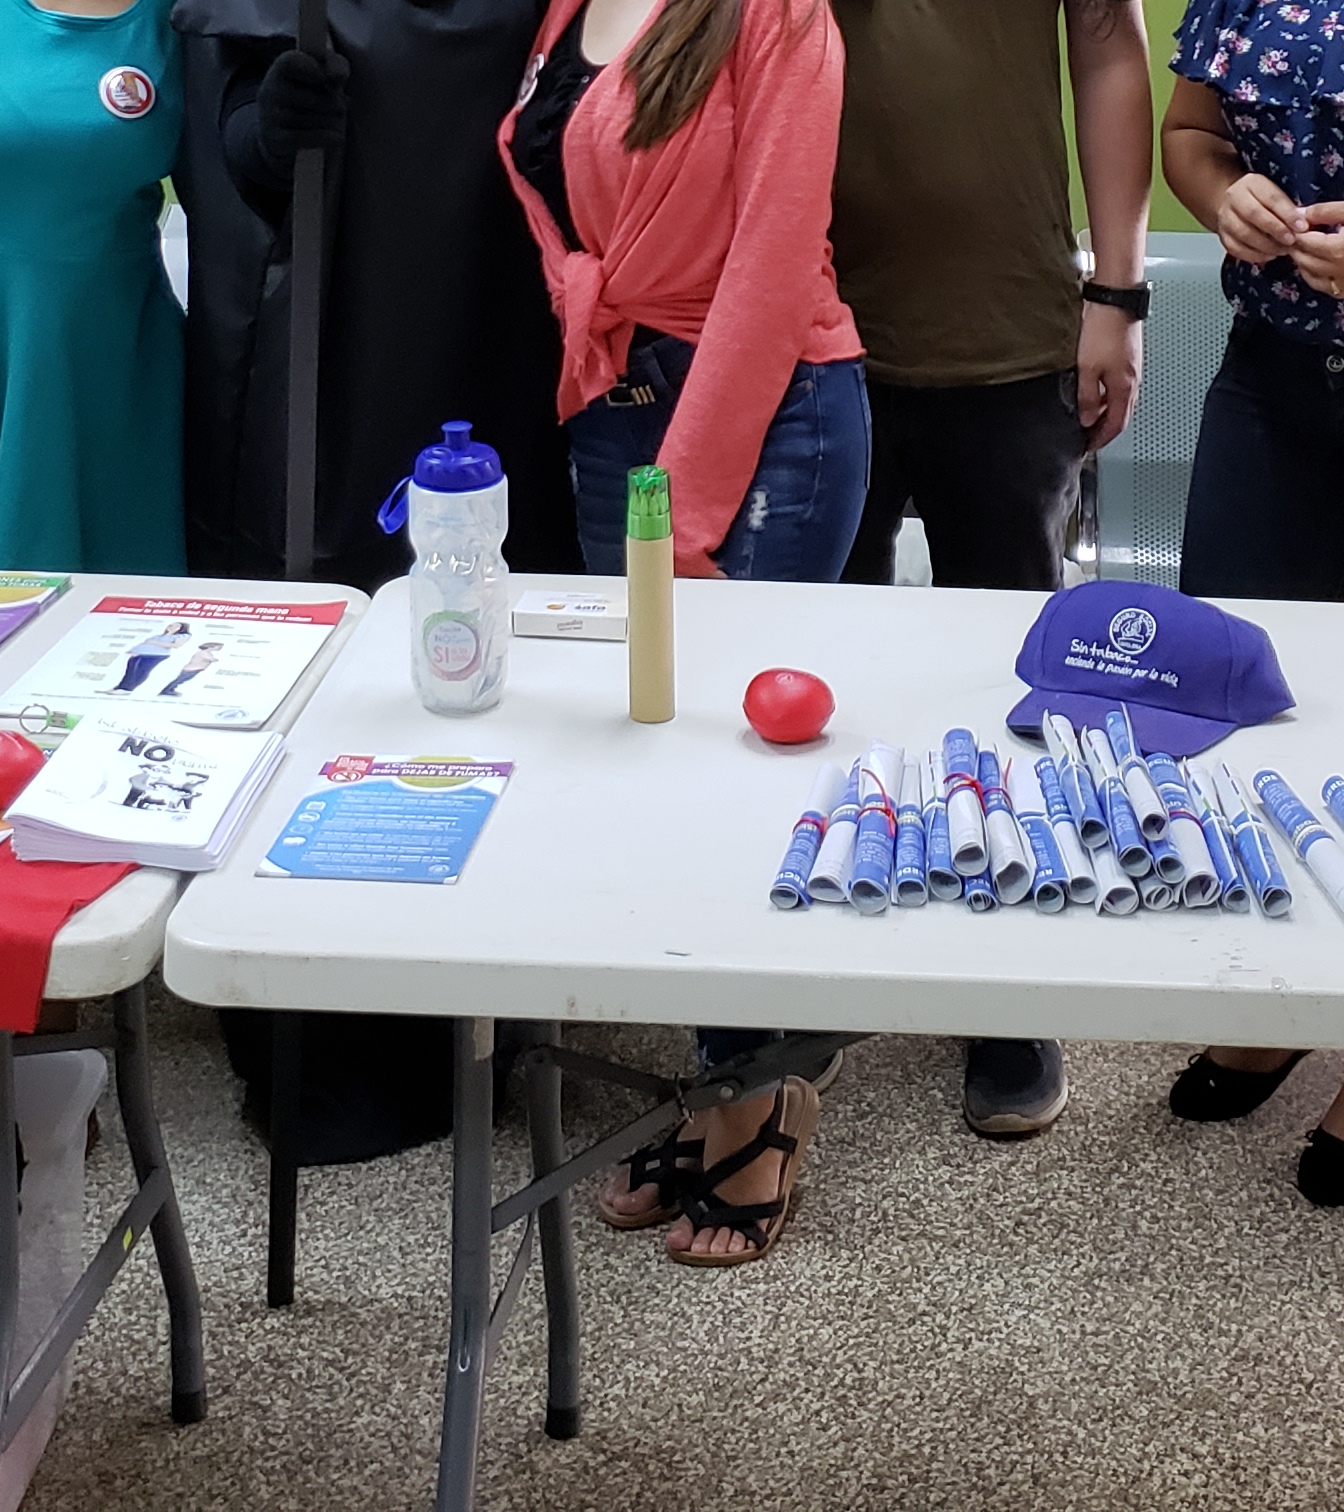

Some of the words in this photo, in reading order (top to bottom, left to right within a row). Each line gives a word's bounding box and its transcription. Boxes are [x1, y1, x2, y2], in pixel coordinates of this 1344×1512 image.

[204, 603, 254, 615] segunda
[256, 606, 289, 615] mano
[1070, 638, 1089, 655] Sin
[117, 735, 176, 762] NO
[401, 768, 436, 777] DEJAR
[438, 769, 454, 777] DE
